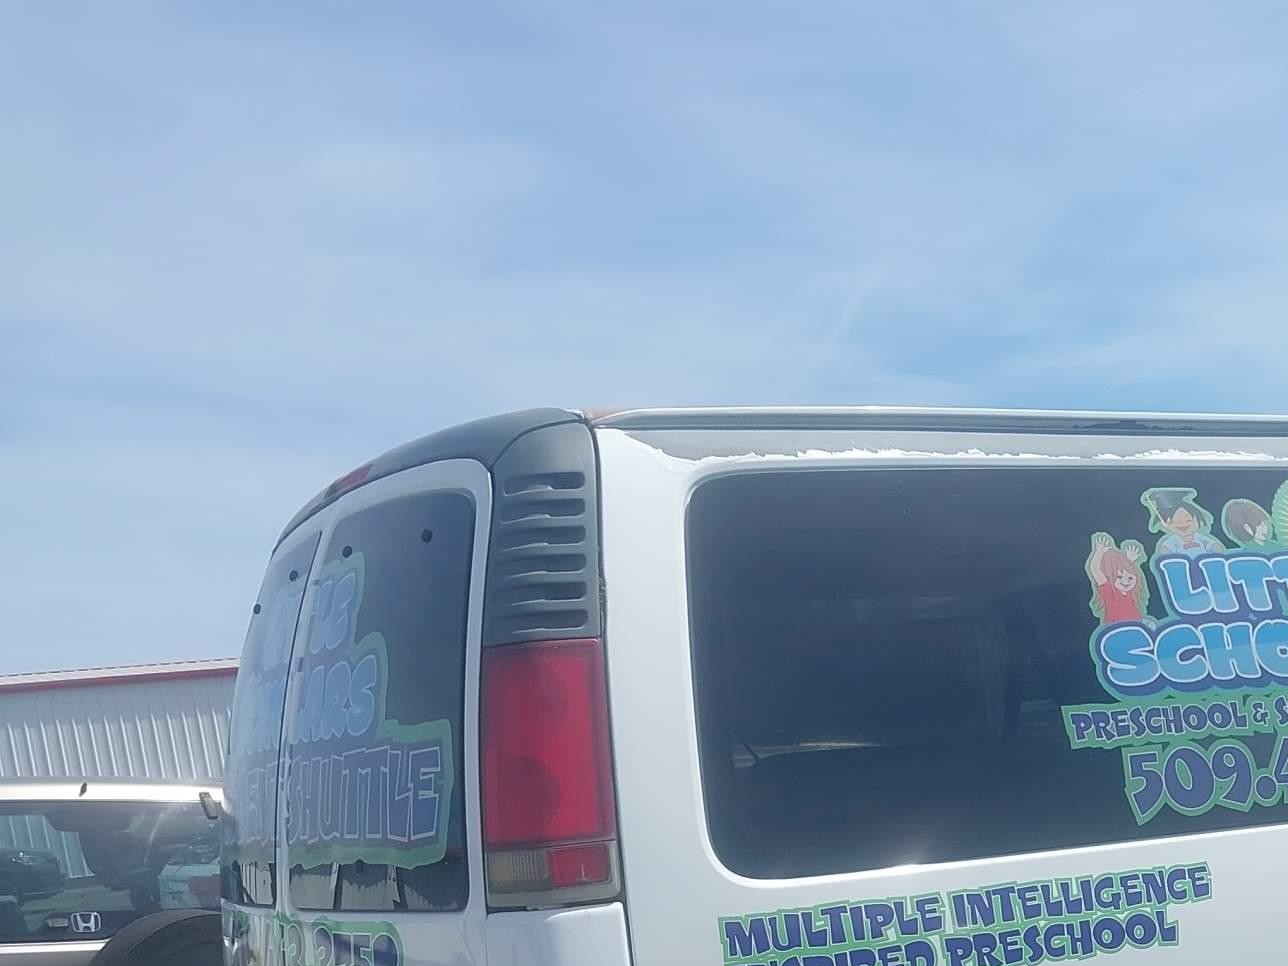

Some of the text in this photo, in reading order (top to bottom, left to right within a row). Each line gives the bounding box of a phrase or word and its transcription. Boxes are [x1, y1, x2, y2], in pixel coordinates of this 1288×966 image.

[1070, 701, 1248, 743] PRESCHOOL
[1252, 702, 1269, 724] &
[286, 745, 441, 844] SHUTTLE
[724, 863, 1211, 958] MULTIPLE INTELLIGENCE
